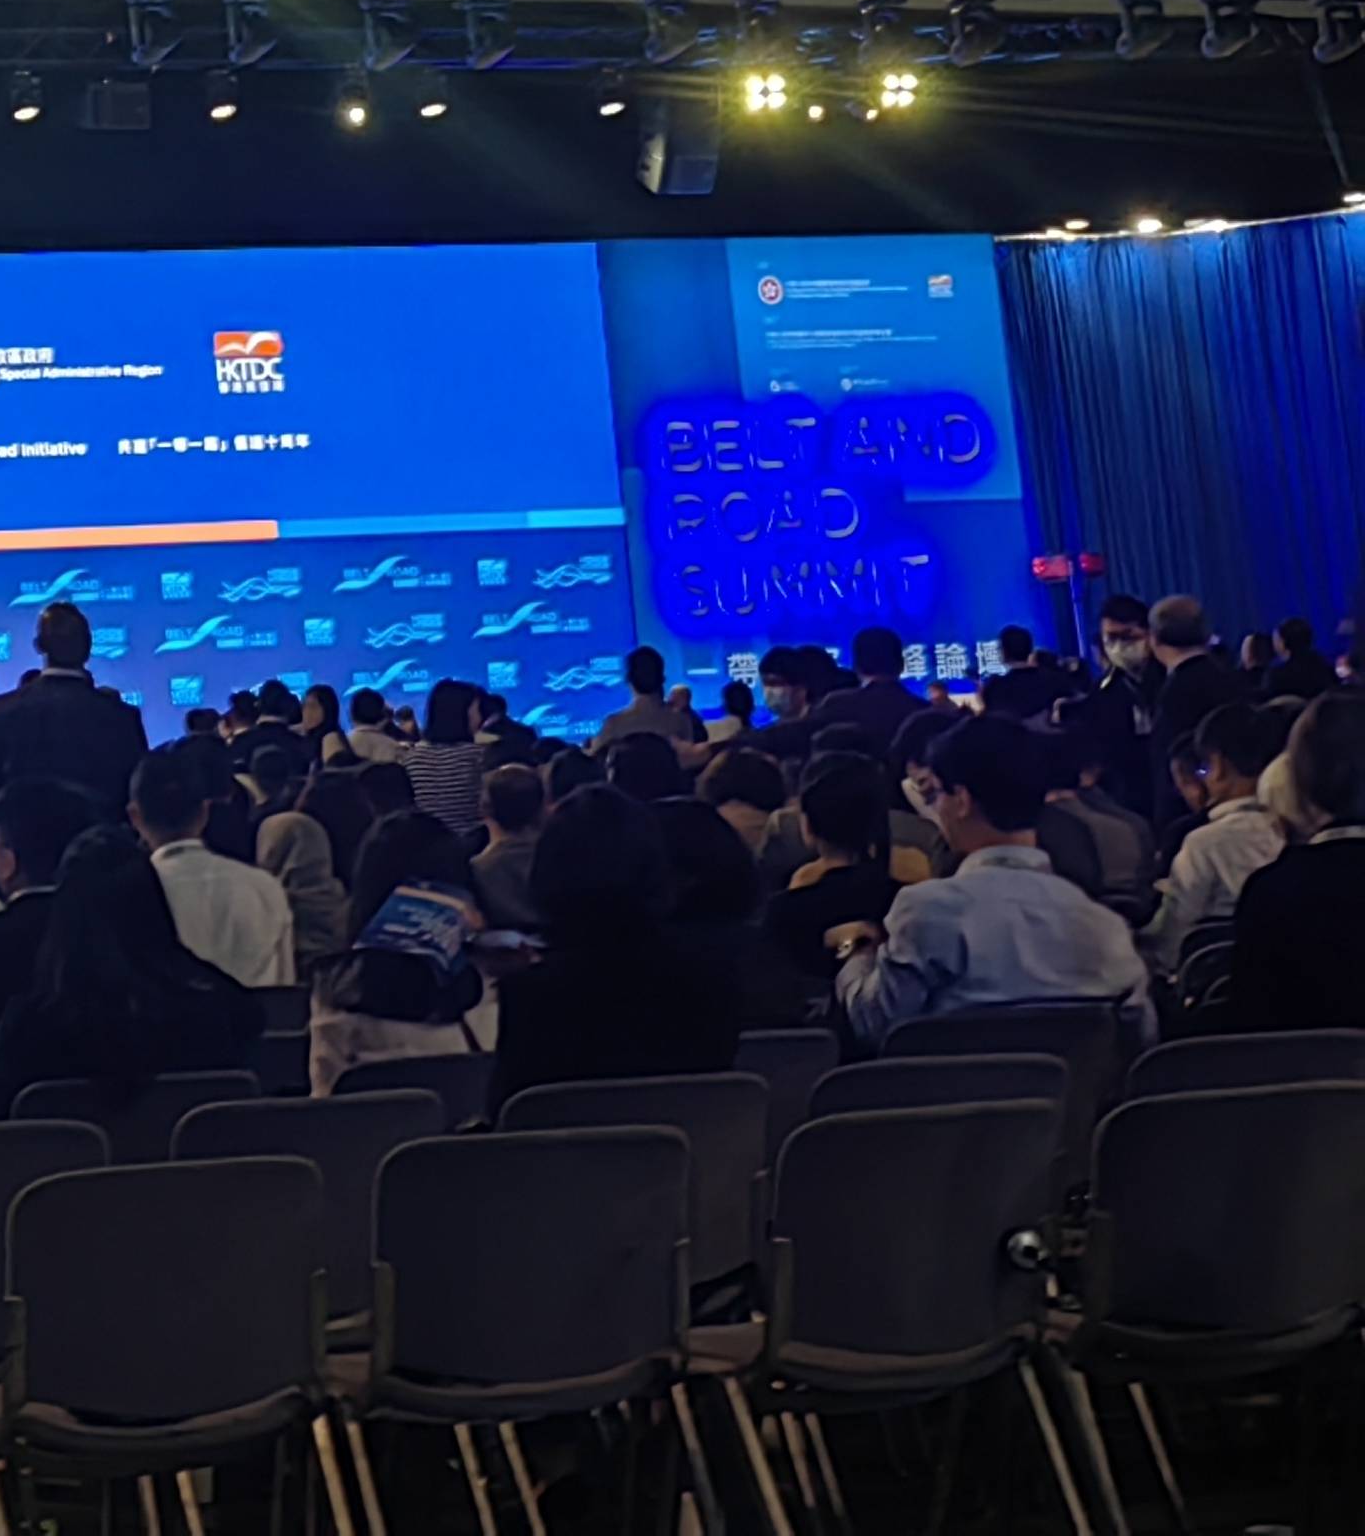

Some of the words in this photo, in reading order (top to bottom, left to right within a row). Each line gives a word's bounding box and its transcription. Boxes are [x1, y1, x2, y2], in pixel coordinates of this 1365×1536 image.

[0, 367, 41, 381] Special
[123, 364, 164, 379] Region
[20, 441, 89, 457] Initiative
